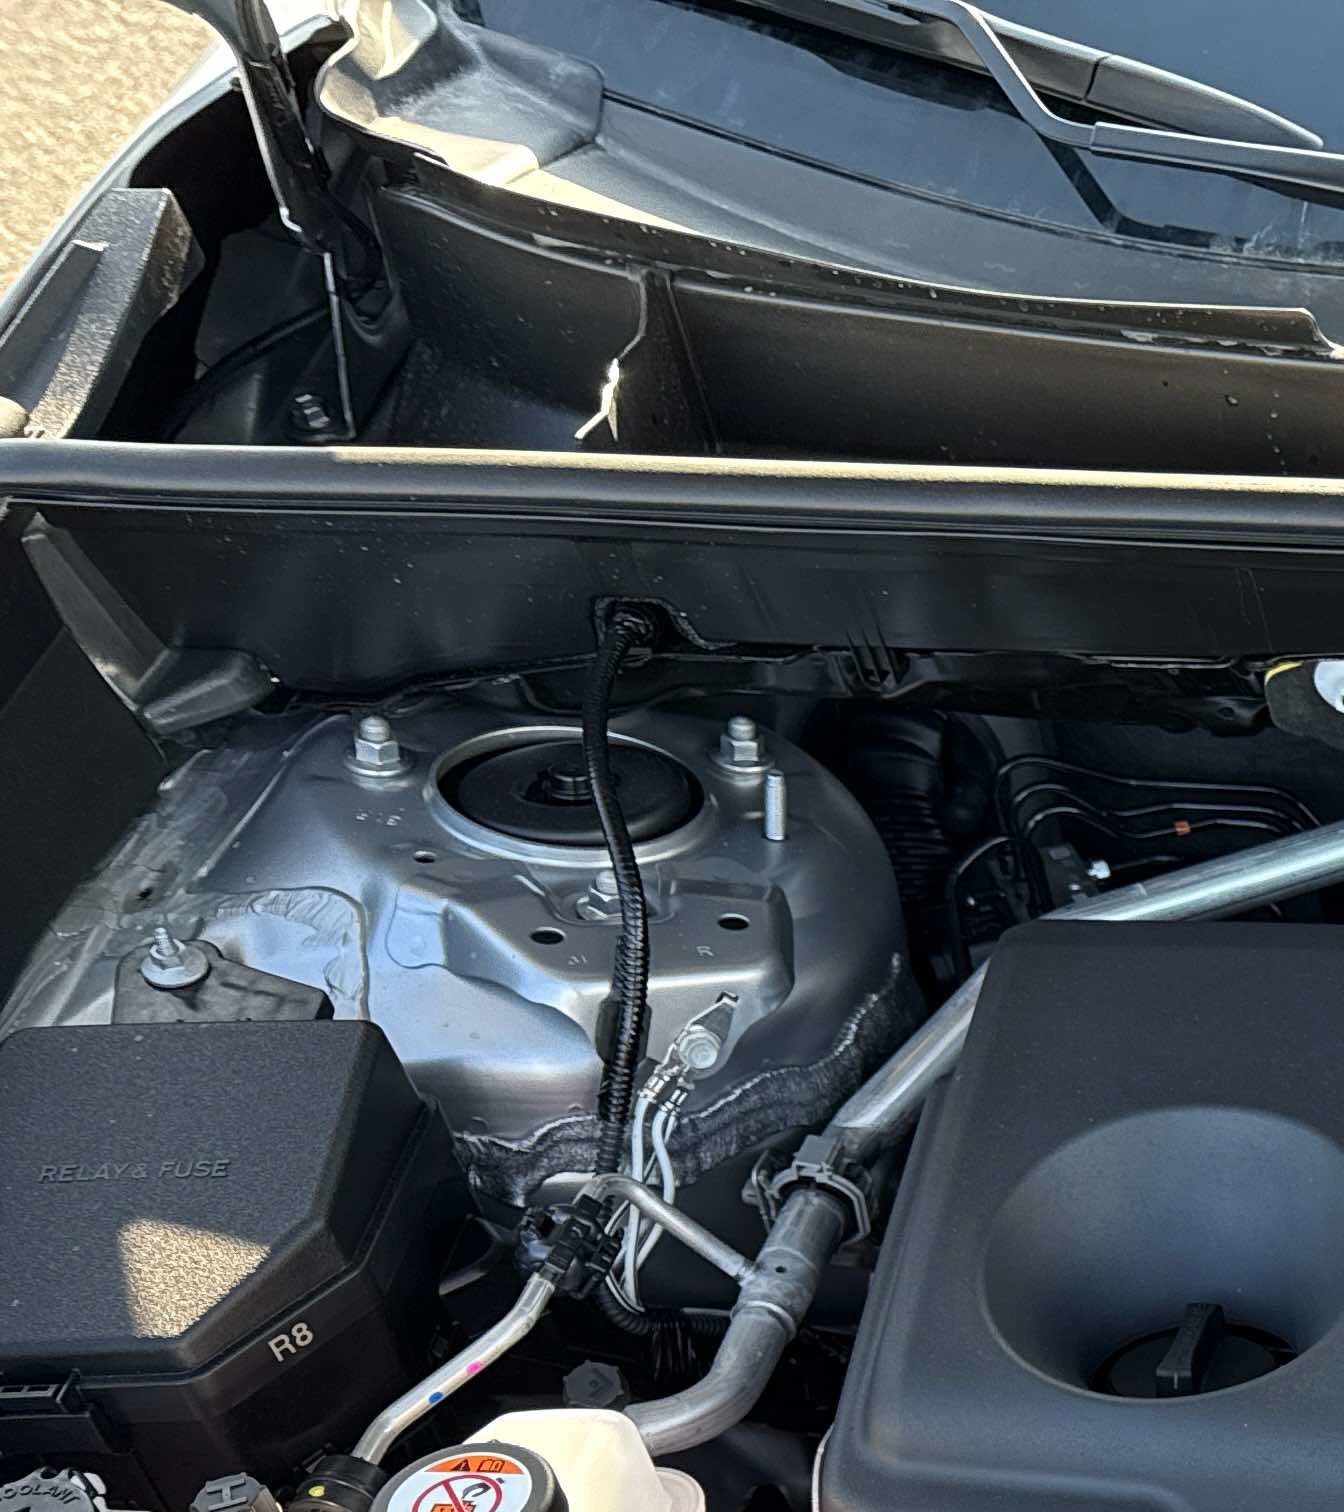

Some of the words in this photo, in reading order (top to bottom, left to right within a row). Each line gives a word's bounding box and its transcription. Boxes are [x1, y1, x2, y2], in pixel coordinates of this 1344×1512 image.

[37, 1162, 133, 1184] RELAY
[131, 1162, 149, 1180] &
[157, 1159, 231, 1179] FUSE
[267, 1321, 315, 1363] R8
[0, 1484, 82, 1505] OOLANT
